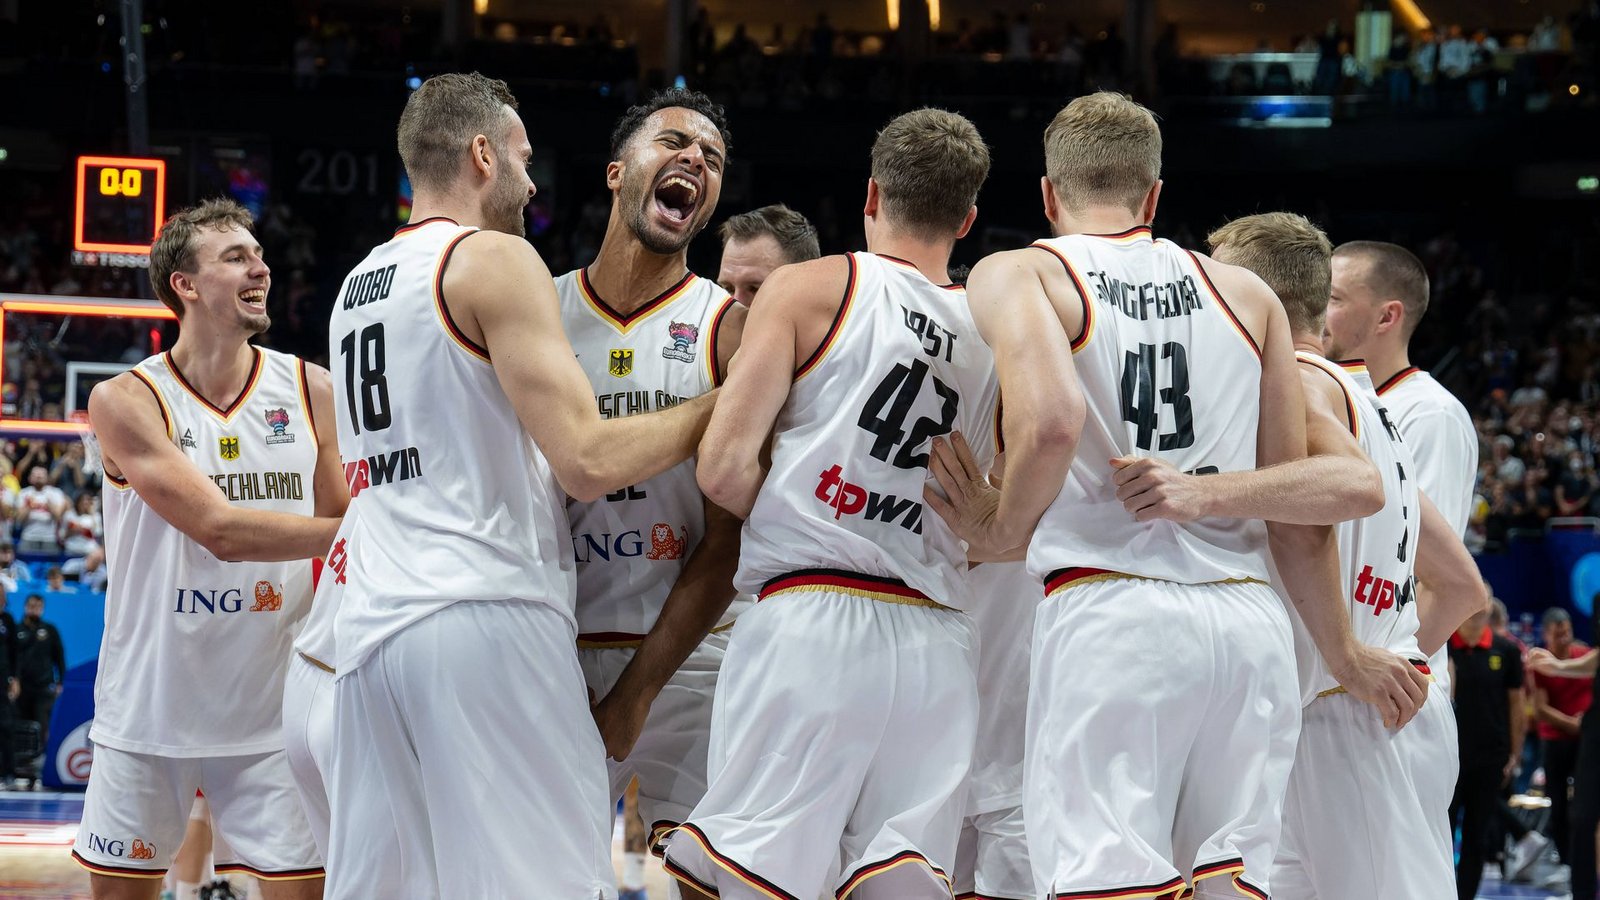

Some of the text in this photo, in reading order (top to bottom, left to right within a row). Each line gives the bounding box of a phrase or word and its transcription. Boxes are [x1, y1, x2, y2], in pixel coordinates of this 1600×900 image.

[298, 149, 377, 196] 201
[97, 252, 152, 268] TISSO
[343, 263, 398, 311] WOBO
[340, 322, 392, 437] 18
[1120, 341, 1195, 451] 43
[857, 358, 959, 469] 42
[209, 471, 303, 501] SCHLAND
[174, 588, 244, 614] ING
[88, 832, 125, 857] ING
